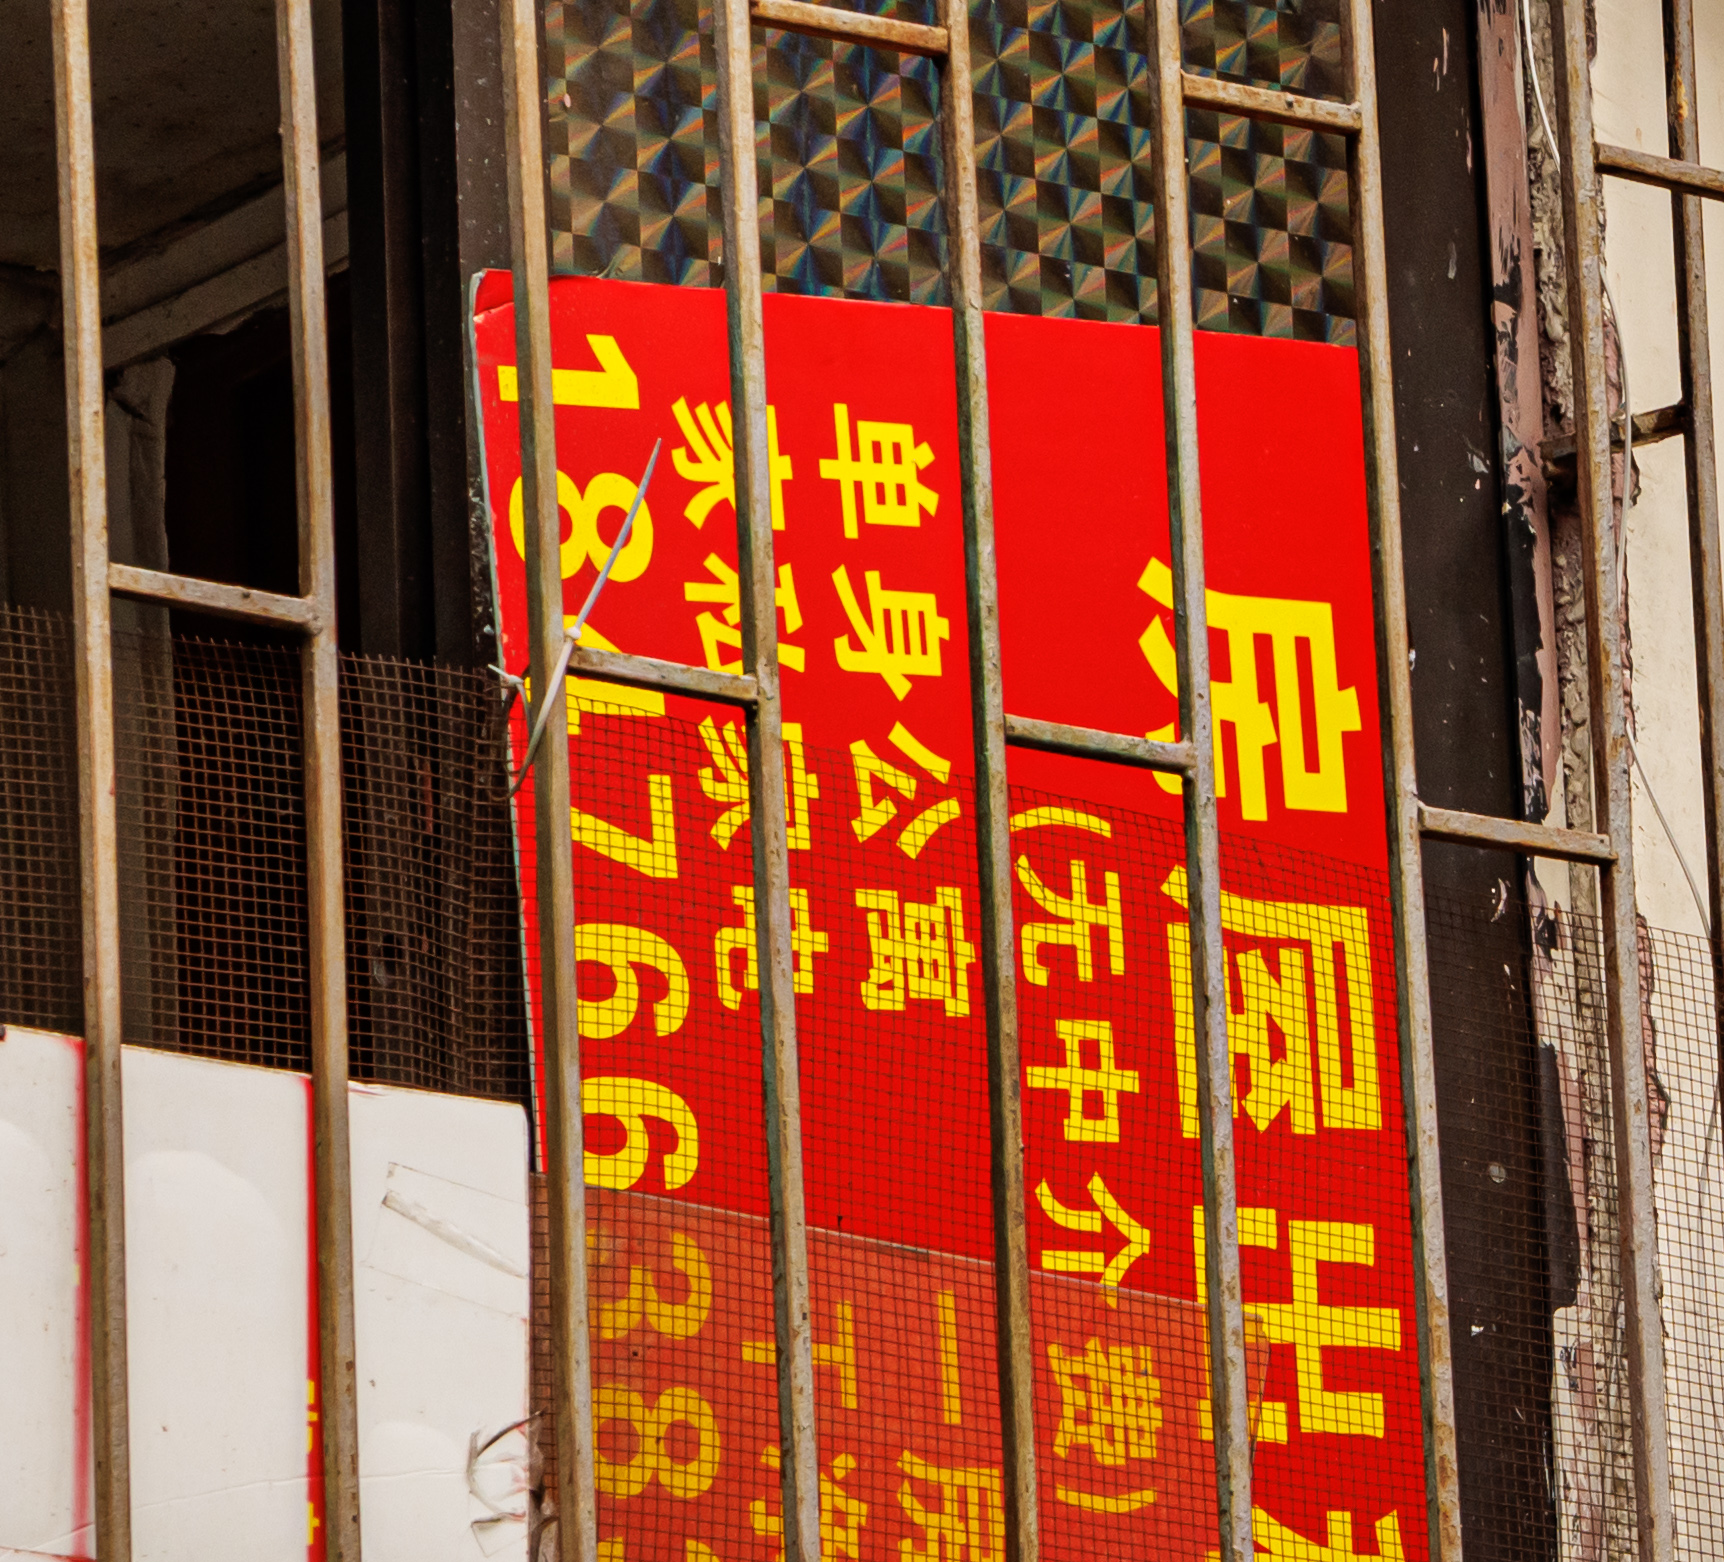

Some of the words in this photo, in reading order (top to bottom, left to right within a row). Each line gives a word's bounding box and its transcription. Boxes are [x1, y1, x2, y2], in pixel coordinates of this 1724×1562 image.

[670, 395, 829, 1010] 家私家电
[818, 402, 978, 1018] 单身公寓
